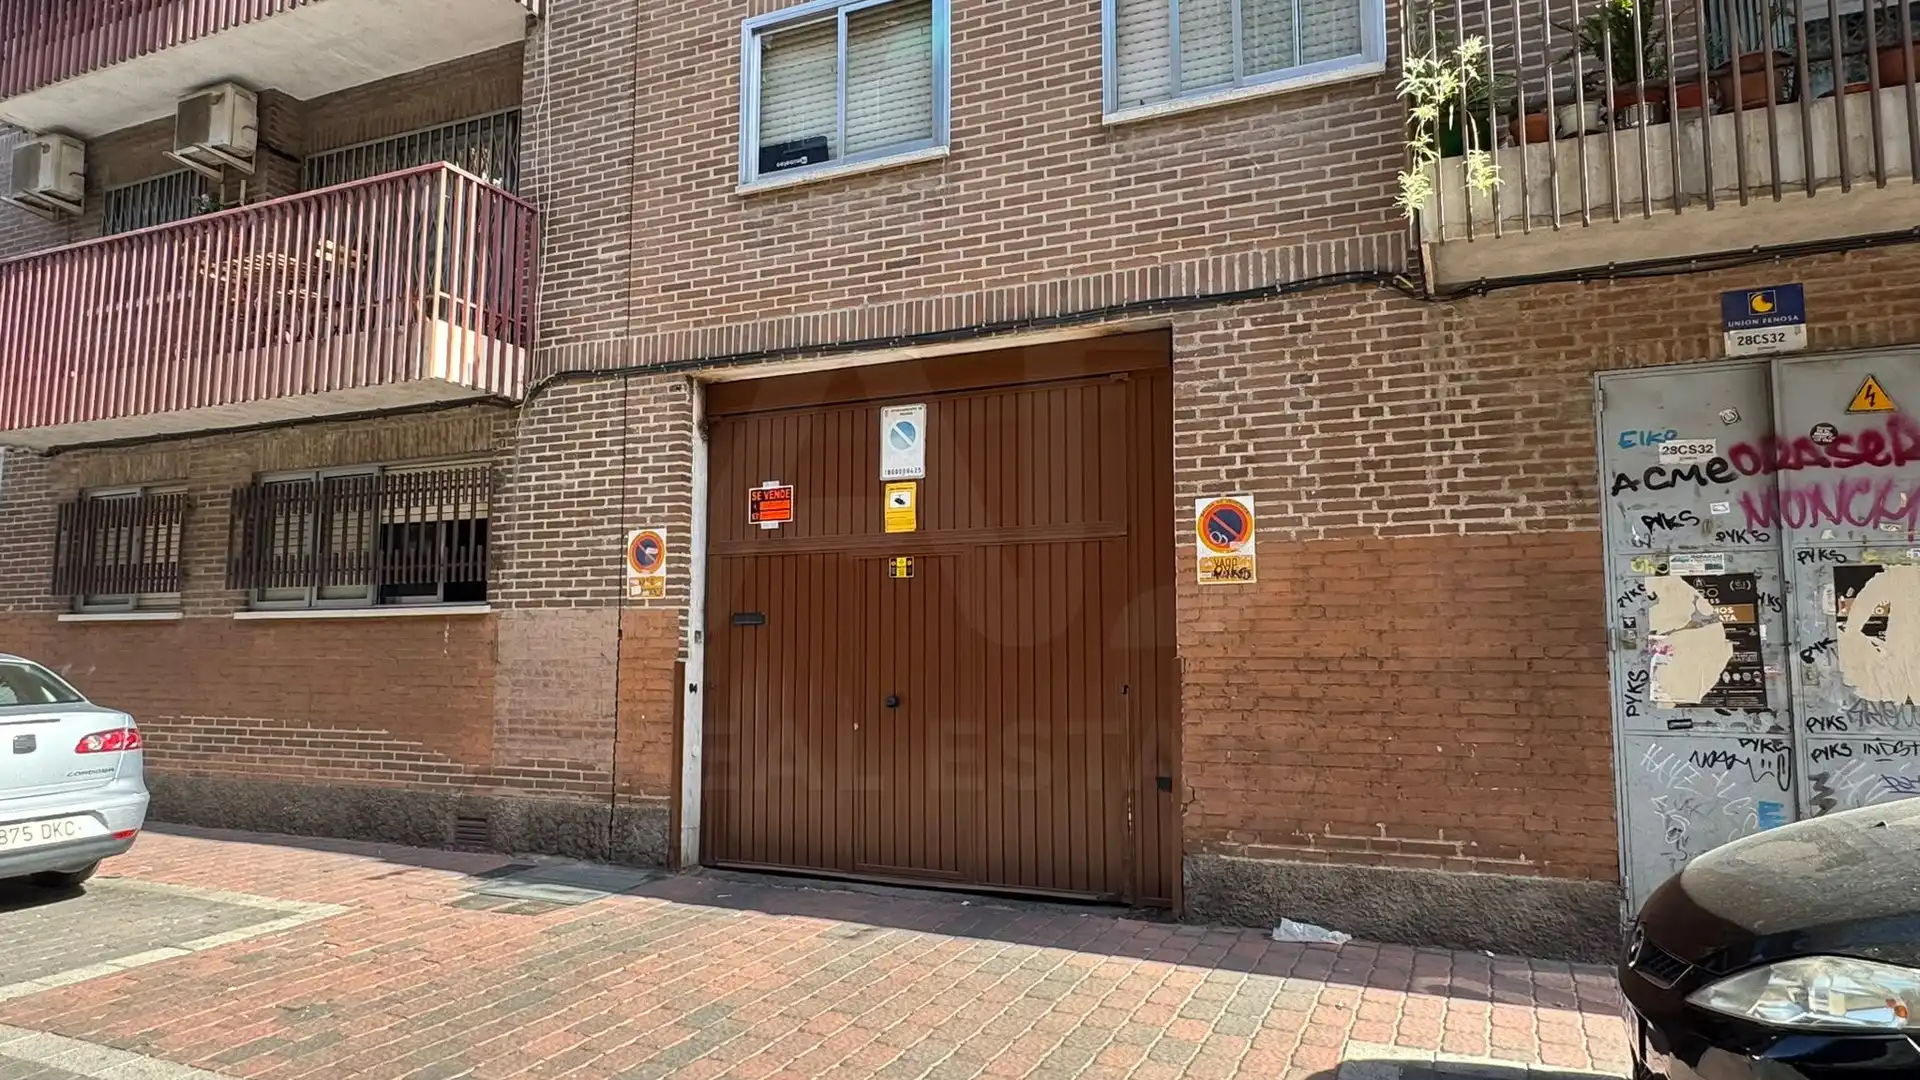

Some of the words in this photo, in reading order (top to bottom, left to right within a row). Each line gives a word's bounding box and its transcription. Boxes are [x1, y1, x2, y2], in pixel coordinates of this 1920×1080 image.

[1728, 319, 1759, 328] UNION
[1737, 332, 1786, 346] 28CS32
[1661, 443, 1714, 455] 28CS32
[752, 491, 763, 501] SE
[763, 489, 791, 500] VENDE
[41, 821, 75, 840] DKC
